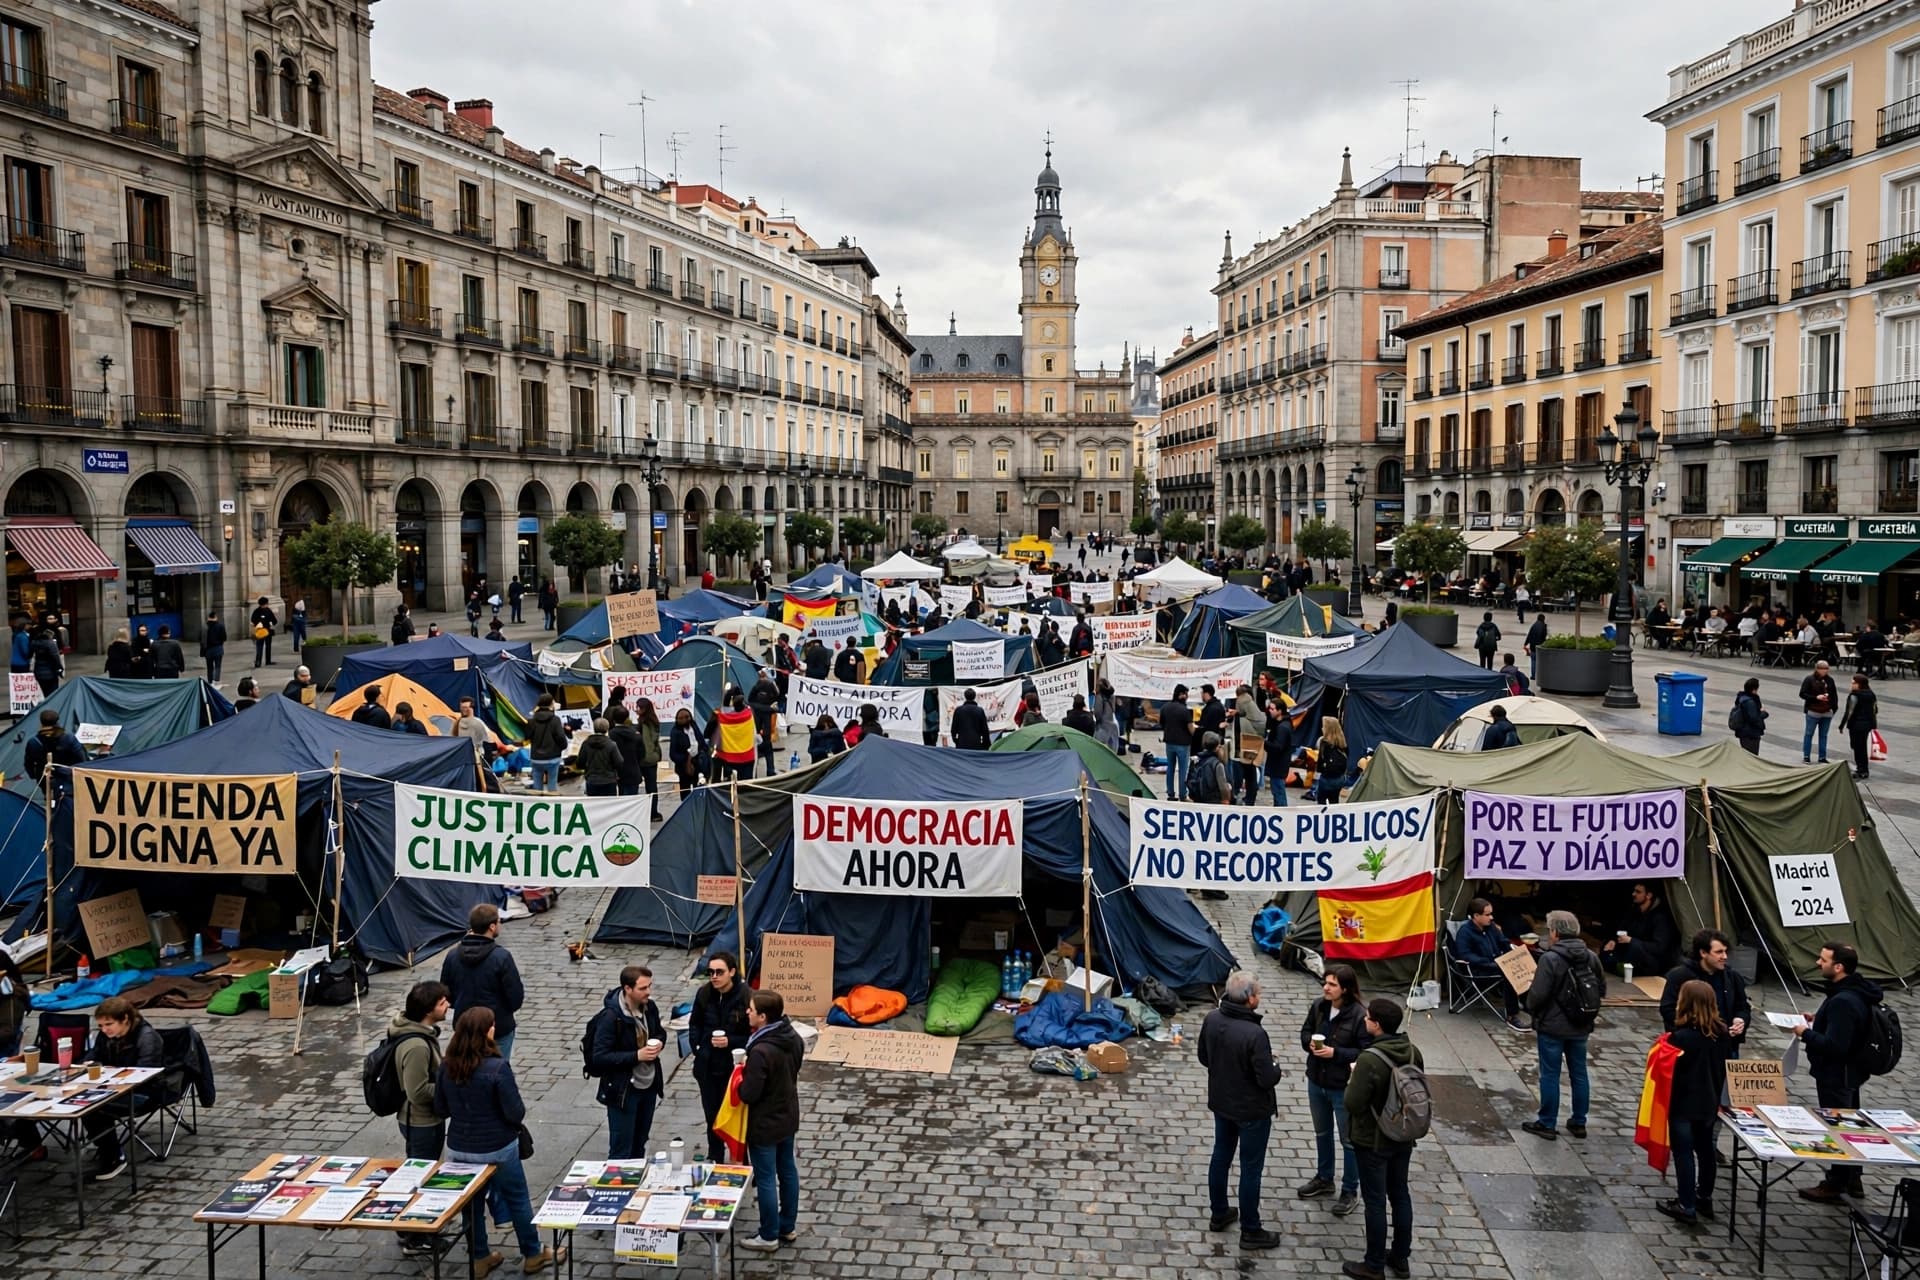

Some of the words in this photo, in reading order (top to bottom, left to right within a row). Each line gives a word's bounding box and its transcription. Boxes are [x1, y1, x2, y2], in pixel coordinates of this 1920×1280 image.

[258, 193, 342, 224] AYUNTAMIENTO
[1793, 521, 1836, 534] CAFETERÍA
[84, 776, 285, 821] VIVIENDA
[410, 793, 593, 836] JUSTICIA
[1471, 800, 1524, 832] POR
[1532, 803, 1563, 833] EL
[1572, 799, 1678, 833] FUTURO
[88, 819, 219, 866] DIGNA
[229, 826, 283, 866] YA
[803, 803, 1016, 846] DEMOCRACIA
[1143, 807, 1284, 845] SERVICIOS
[407, 833, 600, 879] CLIMÁTICA
[842, 848, 966, 890] AHORA
[1195, 849, 1333, 883] RECORTES
[1472, 838, 1527, 870] PAZ
[1536, 840, 1556, 871] Y
[1564, 832, 1680, 872] DÍÁLOGO
[1775, 860, 1830, 880] Madrid
[1791, 897, 1834, 917] 2024
